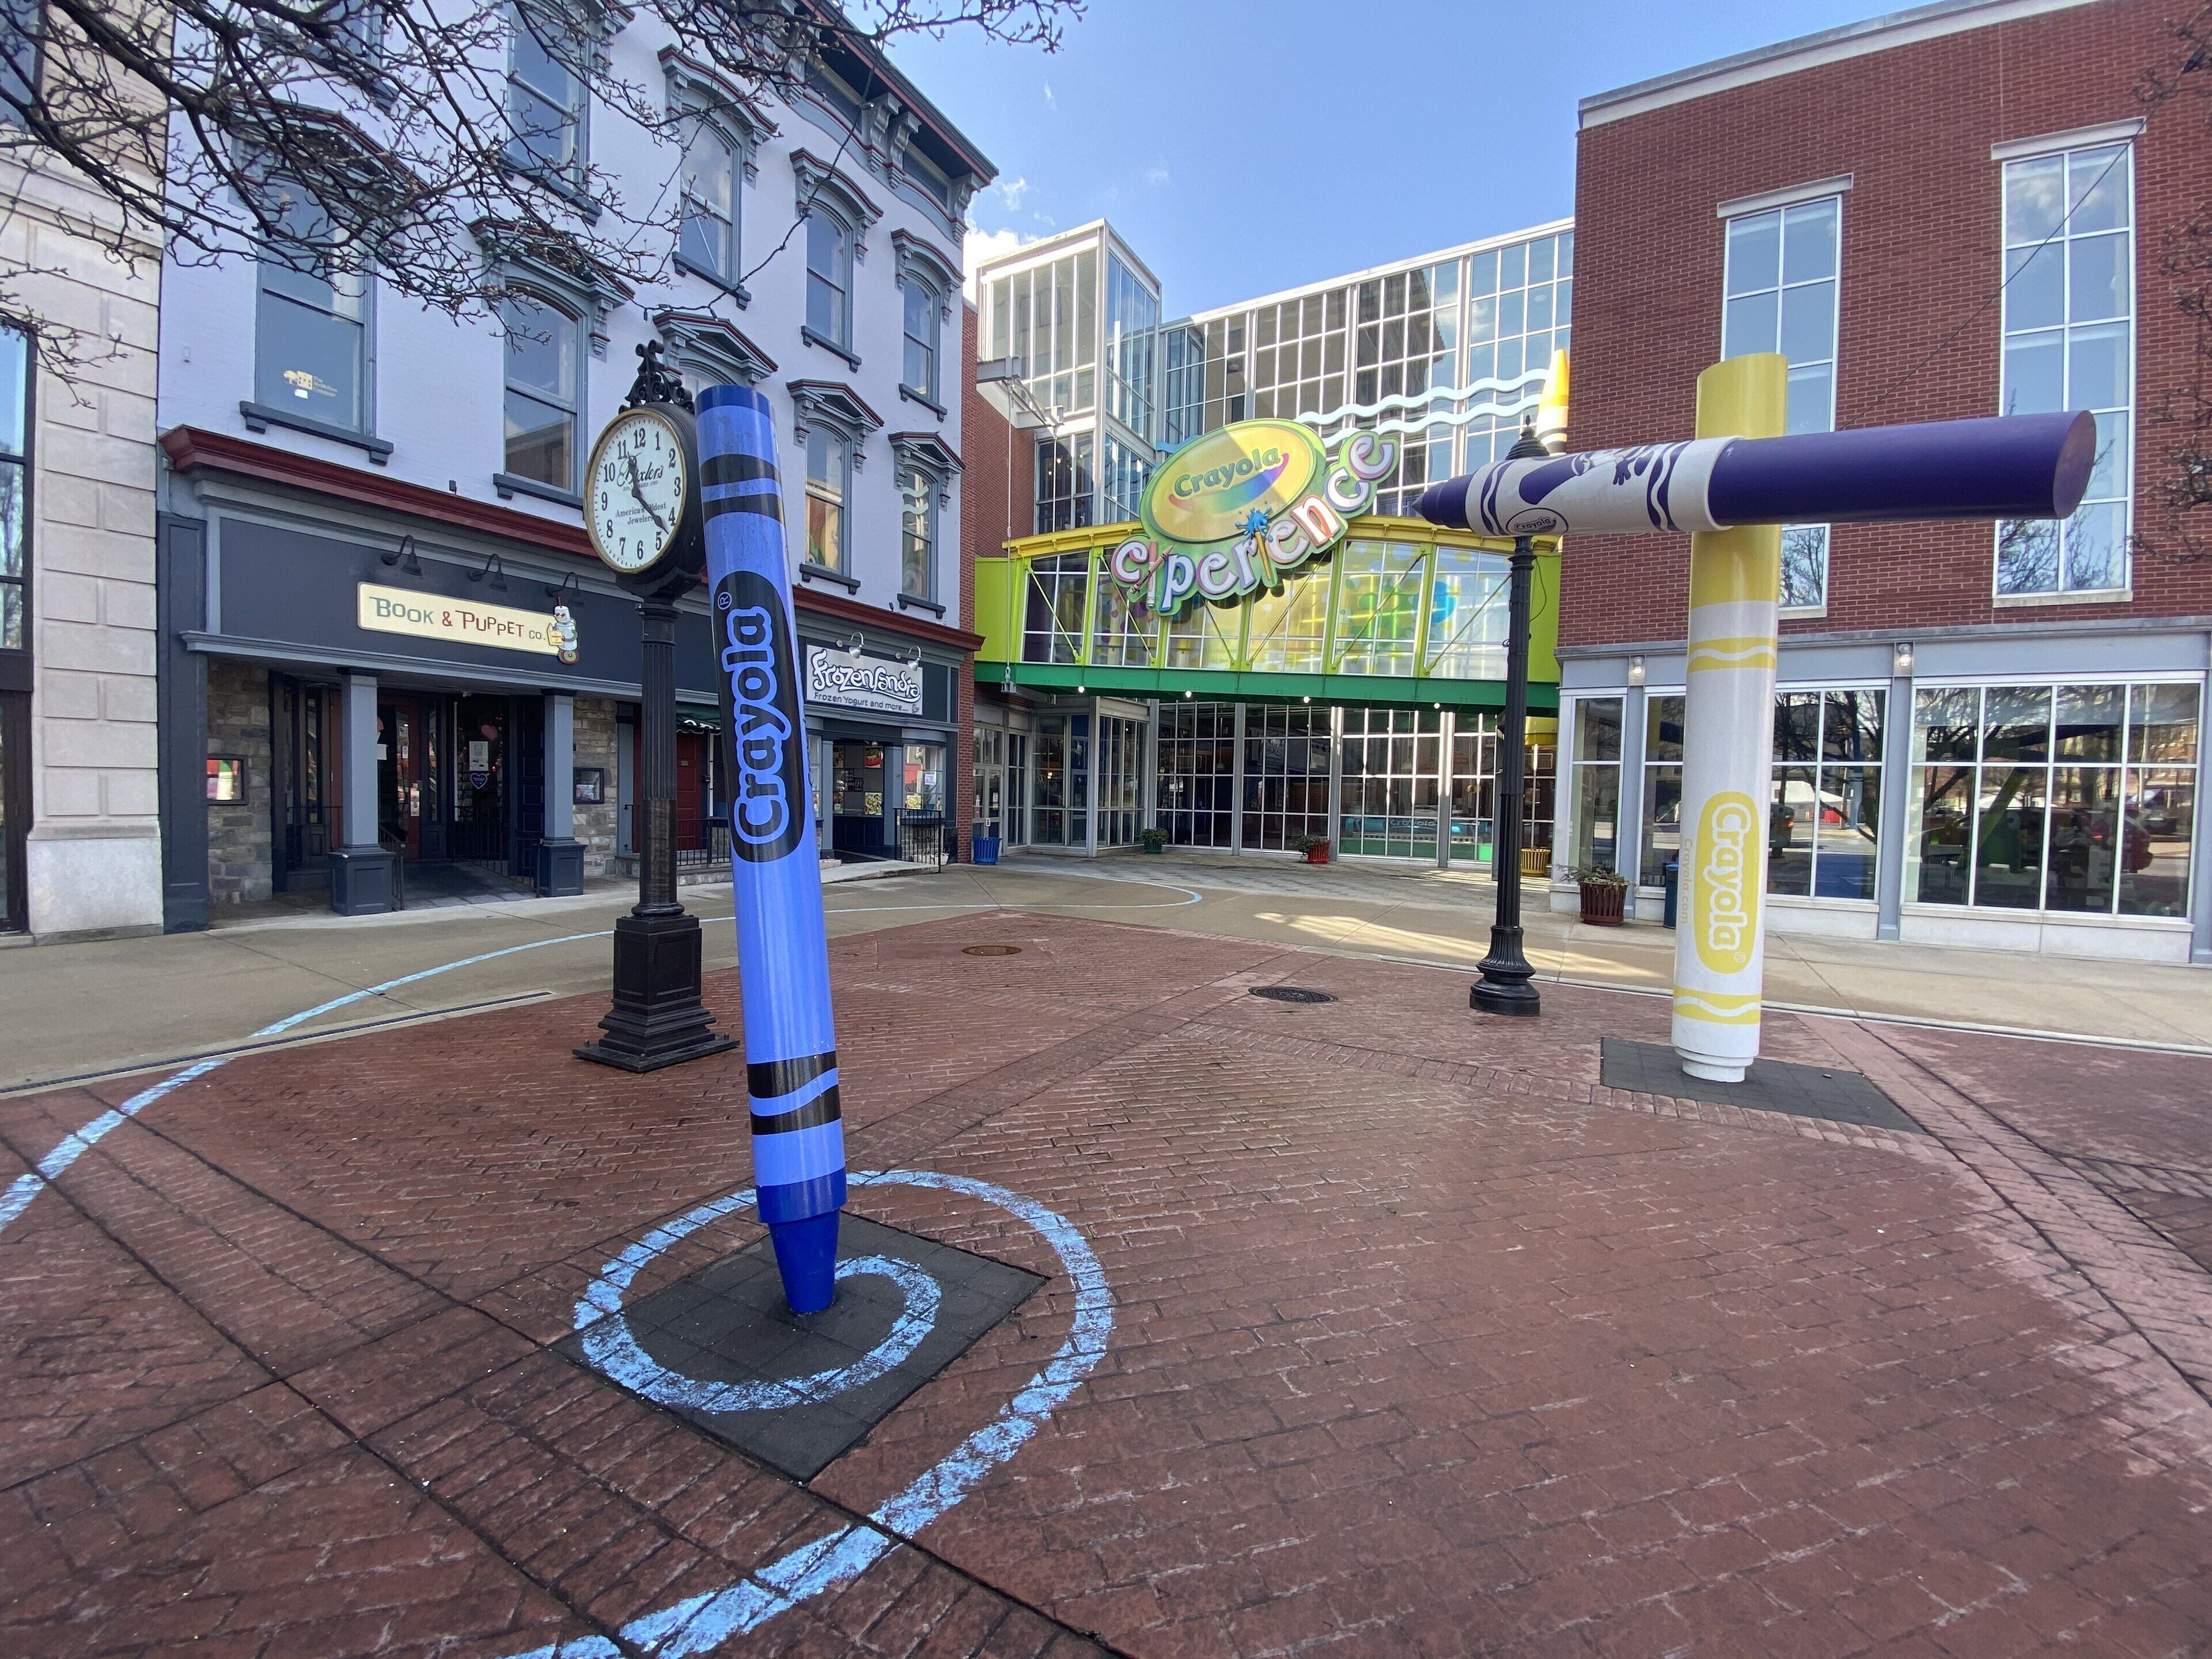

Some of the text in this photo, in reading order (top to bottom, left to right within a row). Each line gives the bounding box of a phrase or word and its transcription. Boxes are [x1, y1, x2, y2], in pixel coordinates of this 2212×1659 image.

[634, 427, 646, 449] 12
[656, 431, 661, 451] 1
[618, 440, 628, 460] 11
[669, 448, 676, 468] 2
[604, 462, 615, 483] 10
[1174, 446, 1281, 497] Crayola
[674, 476, 681, 497] 3
[601, 492, 608, 511] 9
[615, 506, 645, 518] America's
[668, 507, 676, 527] 4
[607, 519, 613, 539] 8
[1516, 518, 1552, 530] Crayola
[619, 537, 626, 556] 7
[637, 540, 643, 560] 6
[656, 531, 662, 551] 5
[442, 611, 453, 627] &
[814, 692, 842, 702] Frozen
[843, 696, 868, 707] Yogurt
[722, 606, 792, 844] Crayola
[1682, 838, 1693, 925] Crayola.com
[1703, 802, 1751, 950] Crayola
